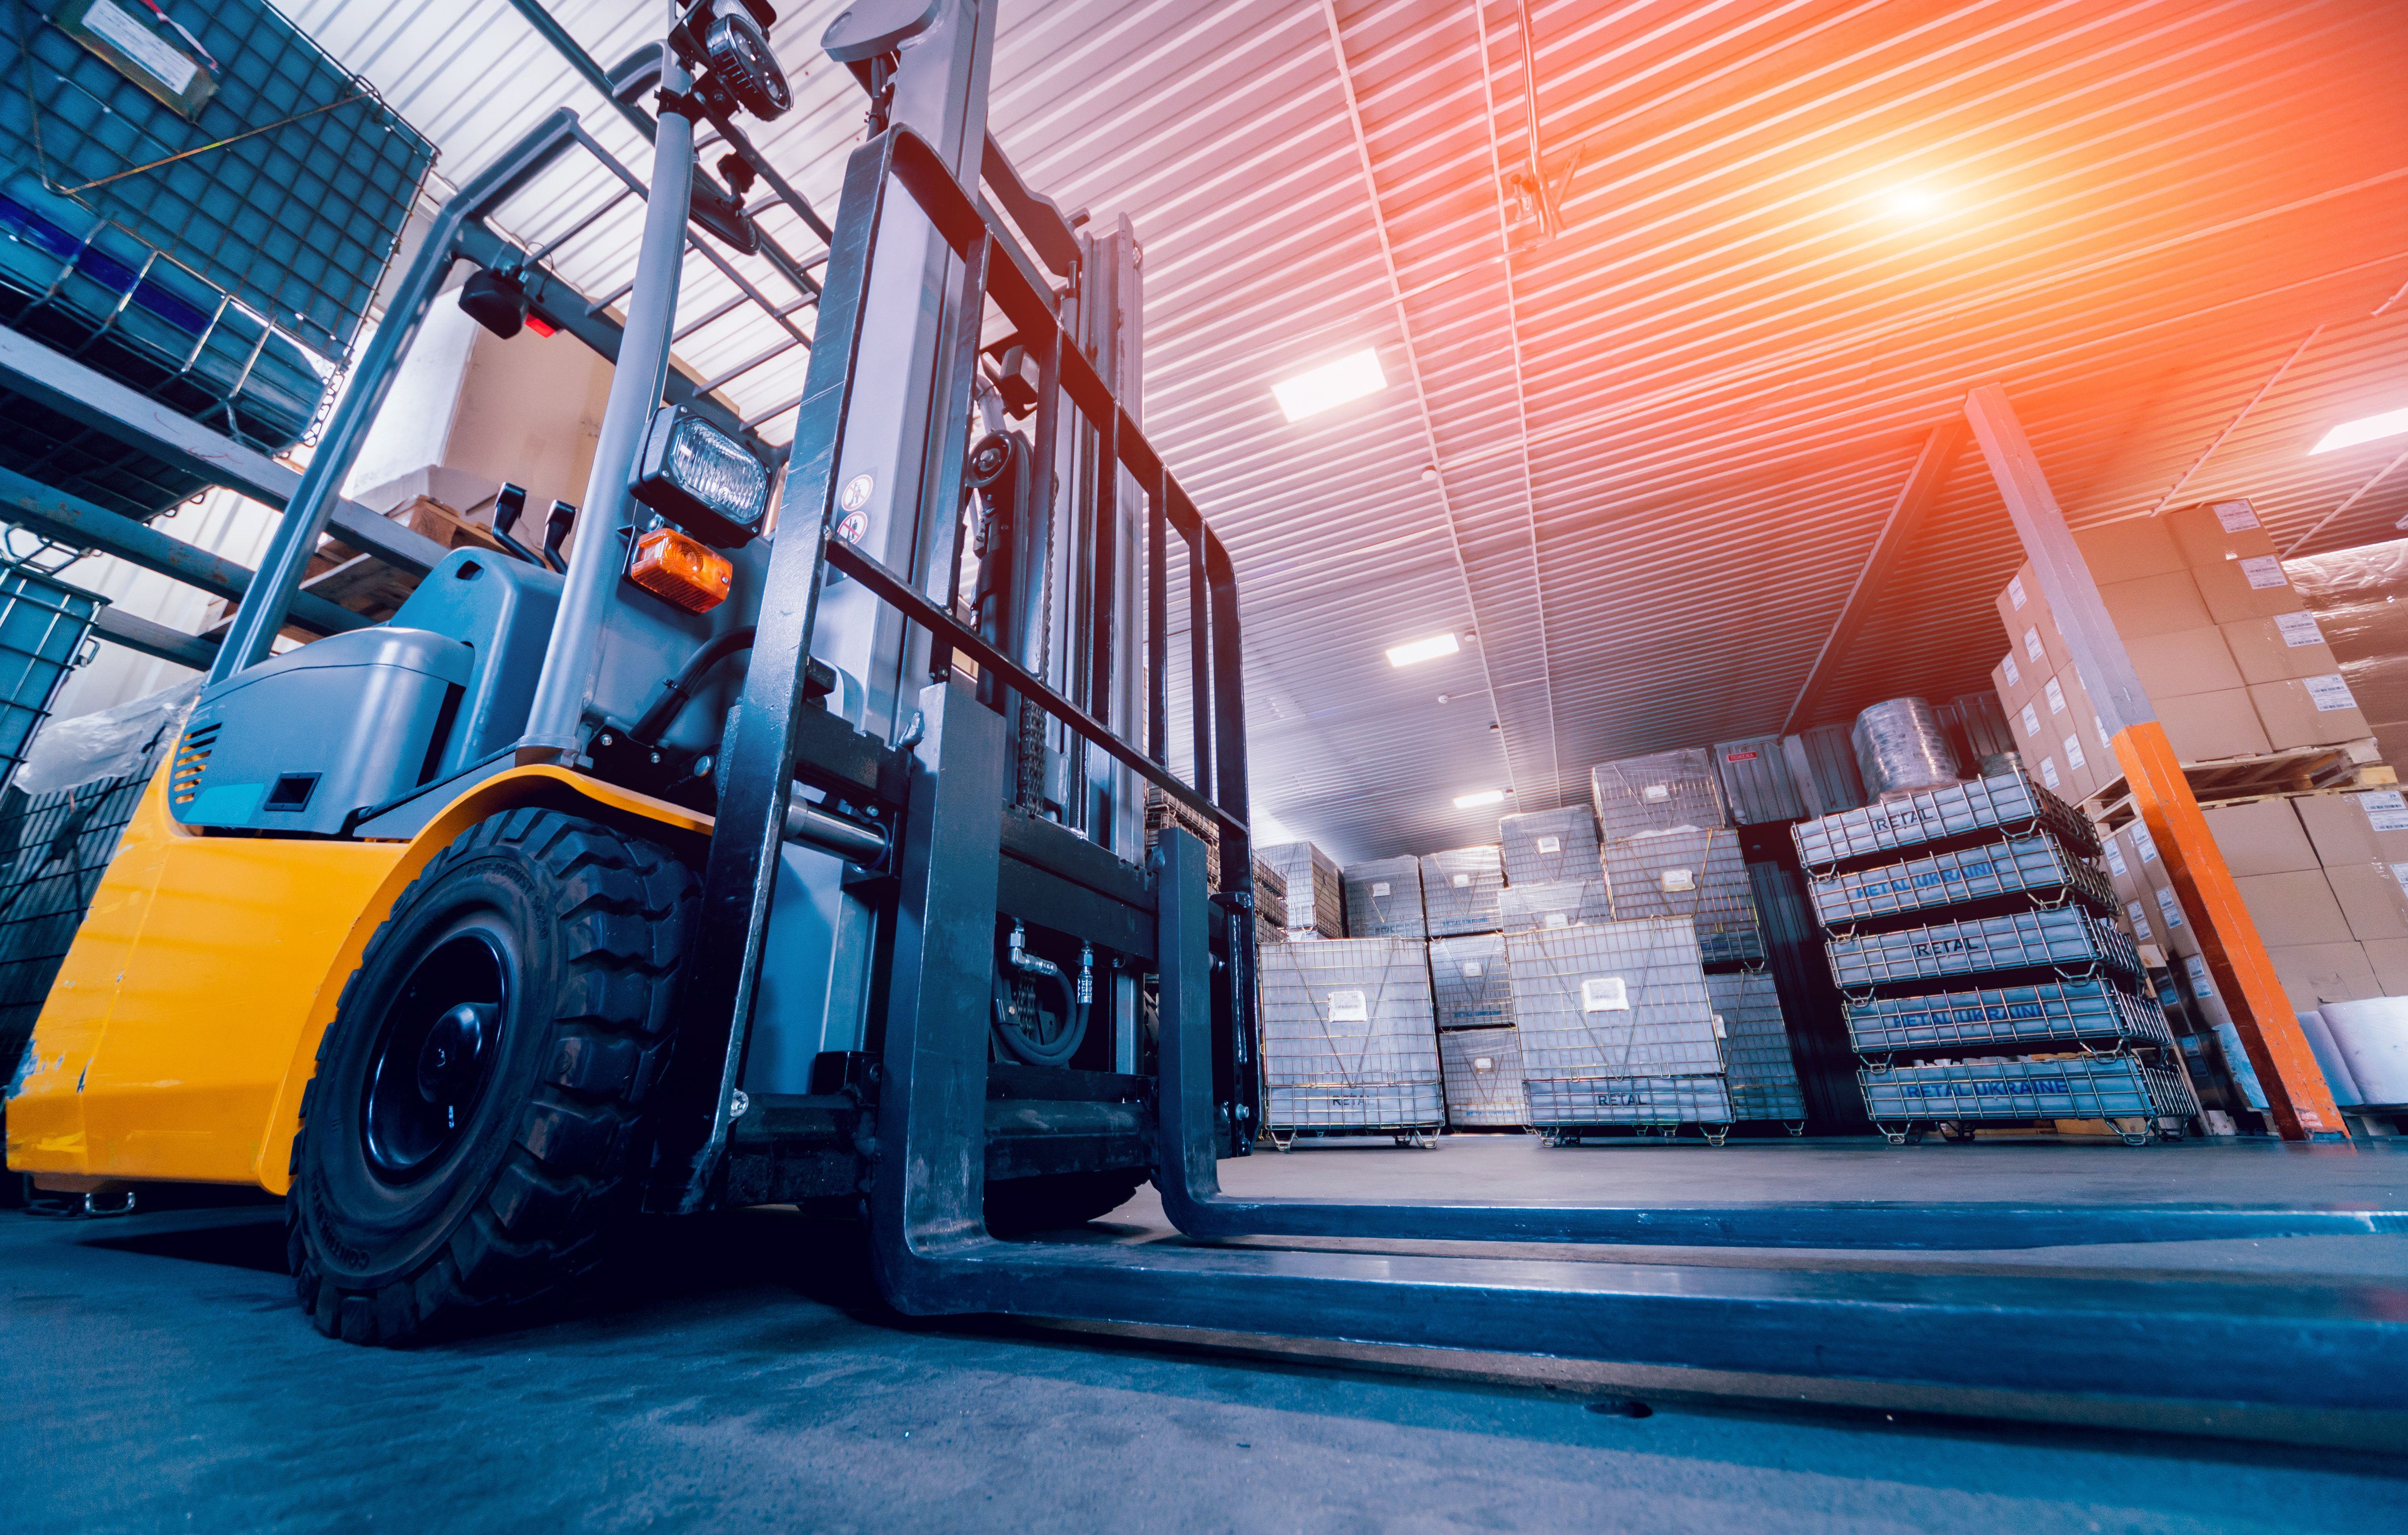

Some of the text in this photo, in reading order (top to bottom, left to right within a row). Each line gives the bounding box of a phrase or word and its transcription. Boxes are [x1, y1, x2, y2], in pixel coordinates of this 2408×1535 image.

[1876, 809, 1933, 831] RETAL
[1856, 861, 2001, 898] RETAL UKRAINE
[1916, 938, 1979, 956] RETAL
[1893, 1004, 2049, 1028] RETAL UKRAINE
[1906, 1080, 2068, 1098] RETAL UKRAINE
[1333, 1095, 1374, 1106] RETAL
[1598, 1094, 1647, 1106] RETAL
